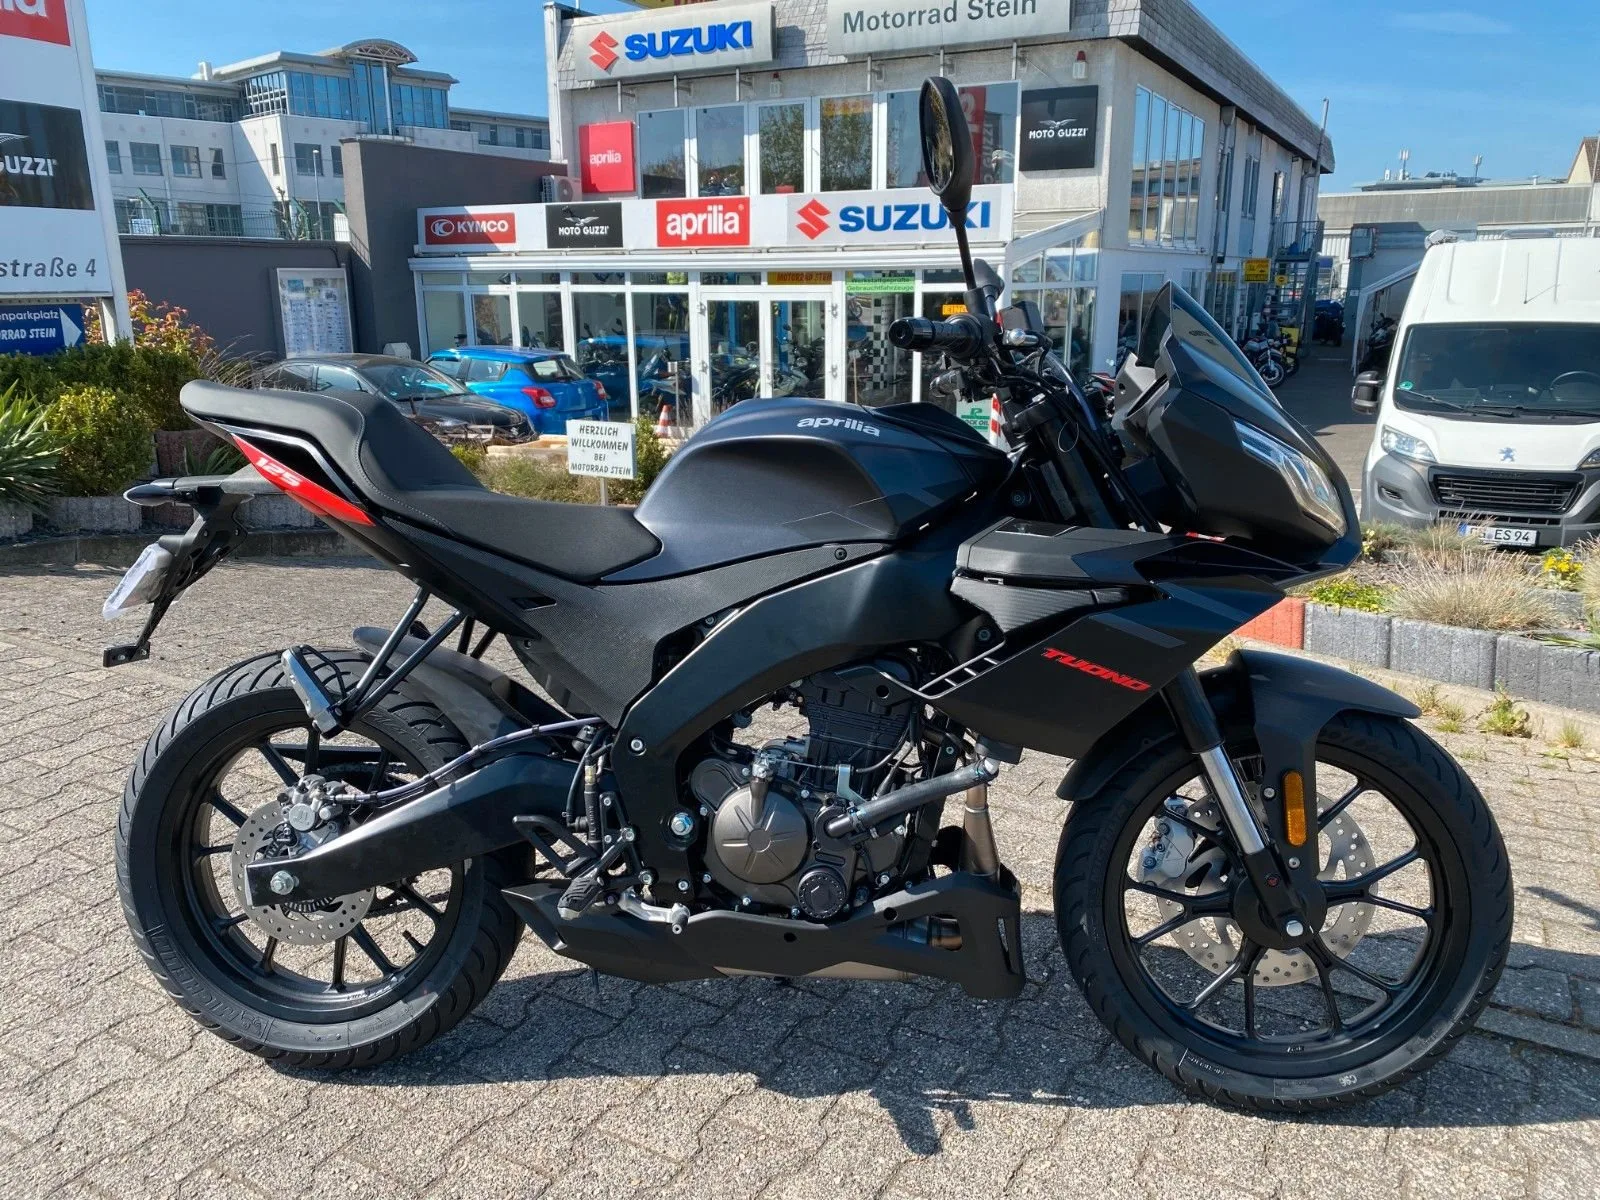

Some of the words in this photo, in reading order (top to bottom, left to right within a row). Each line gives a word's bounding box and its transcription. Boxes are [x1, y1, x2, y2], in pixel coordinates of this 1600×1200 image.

[843, 0, 957, 33] Motorrad
[967, 0, 1036, 20] Stein
[625, 20, 753, 61] SUZUKI
[1028, 129, 1055, 139] MOTO
[1057, 127, 1086, 137] GUZZI
[589, 149, 622, 166] aprilia
[457, 219, 509, 234] KYMCO
[666, 204, 739, 241] aprilia
[558, 226, 581, 236] MOTO
[582, 225, 608, 235] GUZZI
[85, 258, 97, 277] 4
[0, 310, 60, 322] nparkplatz
[0, 328, 27, 341] RRAD
[29, 328, 56, 339] STEIN
[579, 424, 619, 437] HERZLICH
[796, 416, 881, 437] aprilia
[571, 438, 629, 451] WILLKOMMEN
[594, 453, 606, 462] BEI
[256, 457, 303, 487] 125
[571, 463, 609, 473] MOTORRAD
[610, 466, 631, 475] STEIN
[1494, 529, 1511, 541] ES
[1514, 530, 1530, 542] 94
[1041, 647, 1152, 692] TUONO
